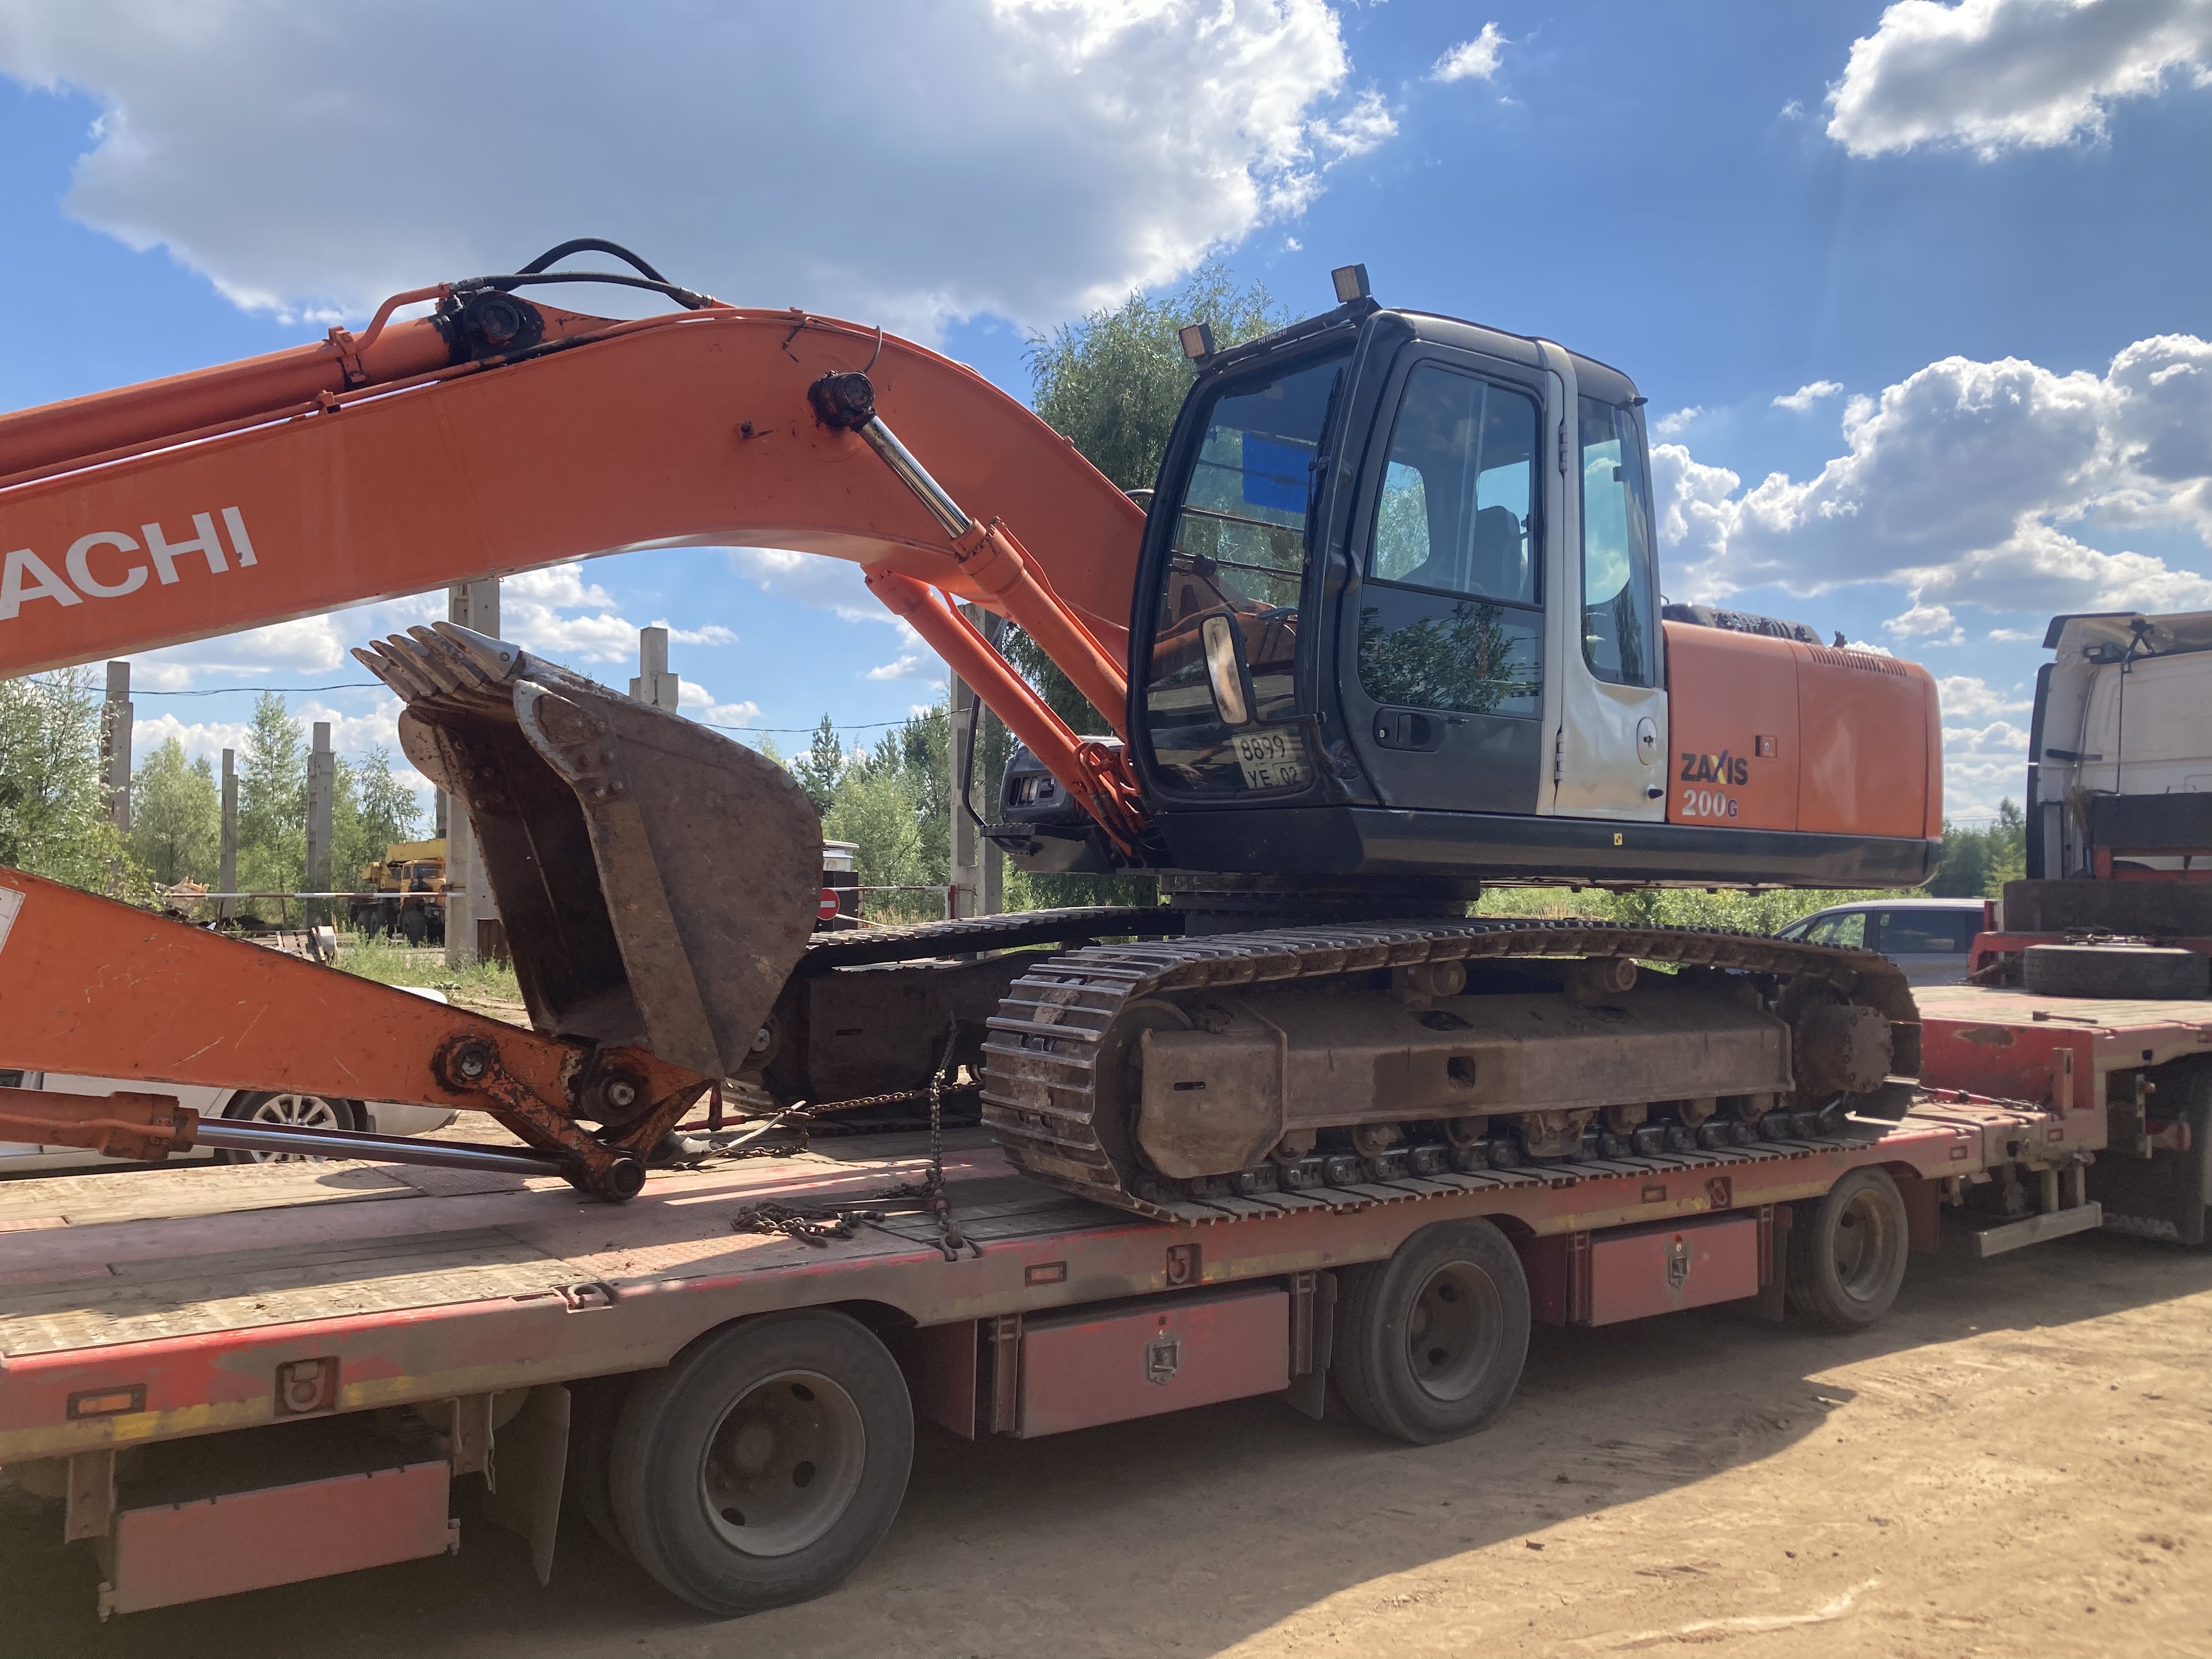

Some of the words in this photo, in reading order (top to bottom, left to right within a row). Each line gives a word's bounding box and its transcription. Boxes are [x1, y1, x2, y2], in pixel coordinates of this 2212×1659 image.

[1258, 328, 1288, 345] HITACHI
[1240, 735, 1285, 761] 8899
[1280, 766, 1301, 784] 02
[1681, 749, 1748, 786] ZAXIS
